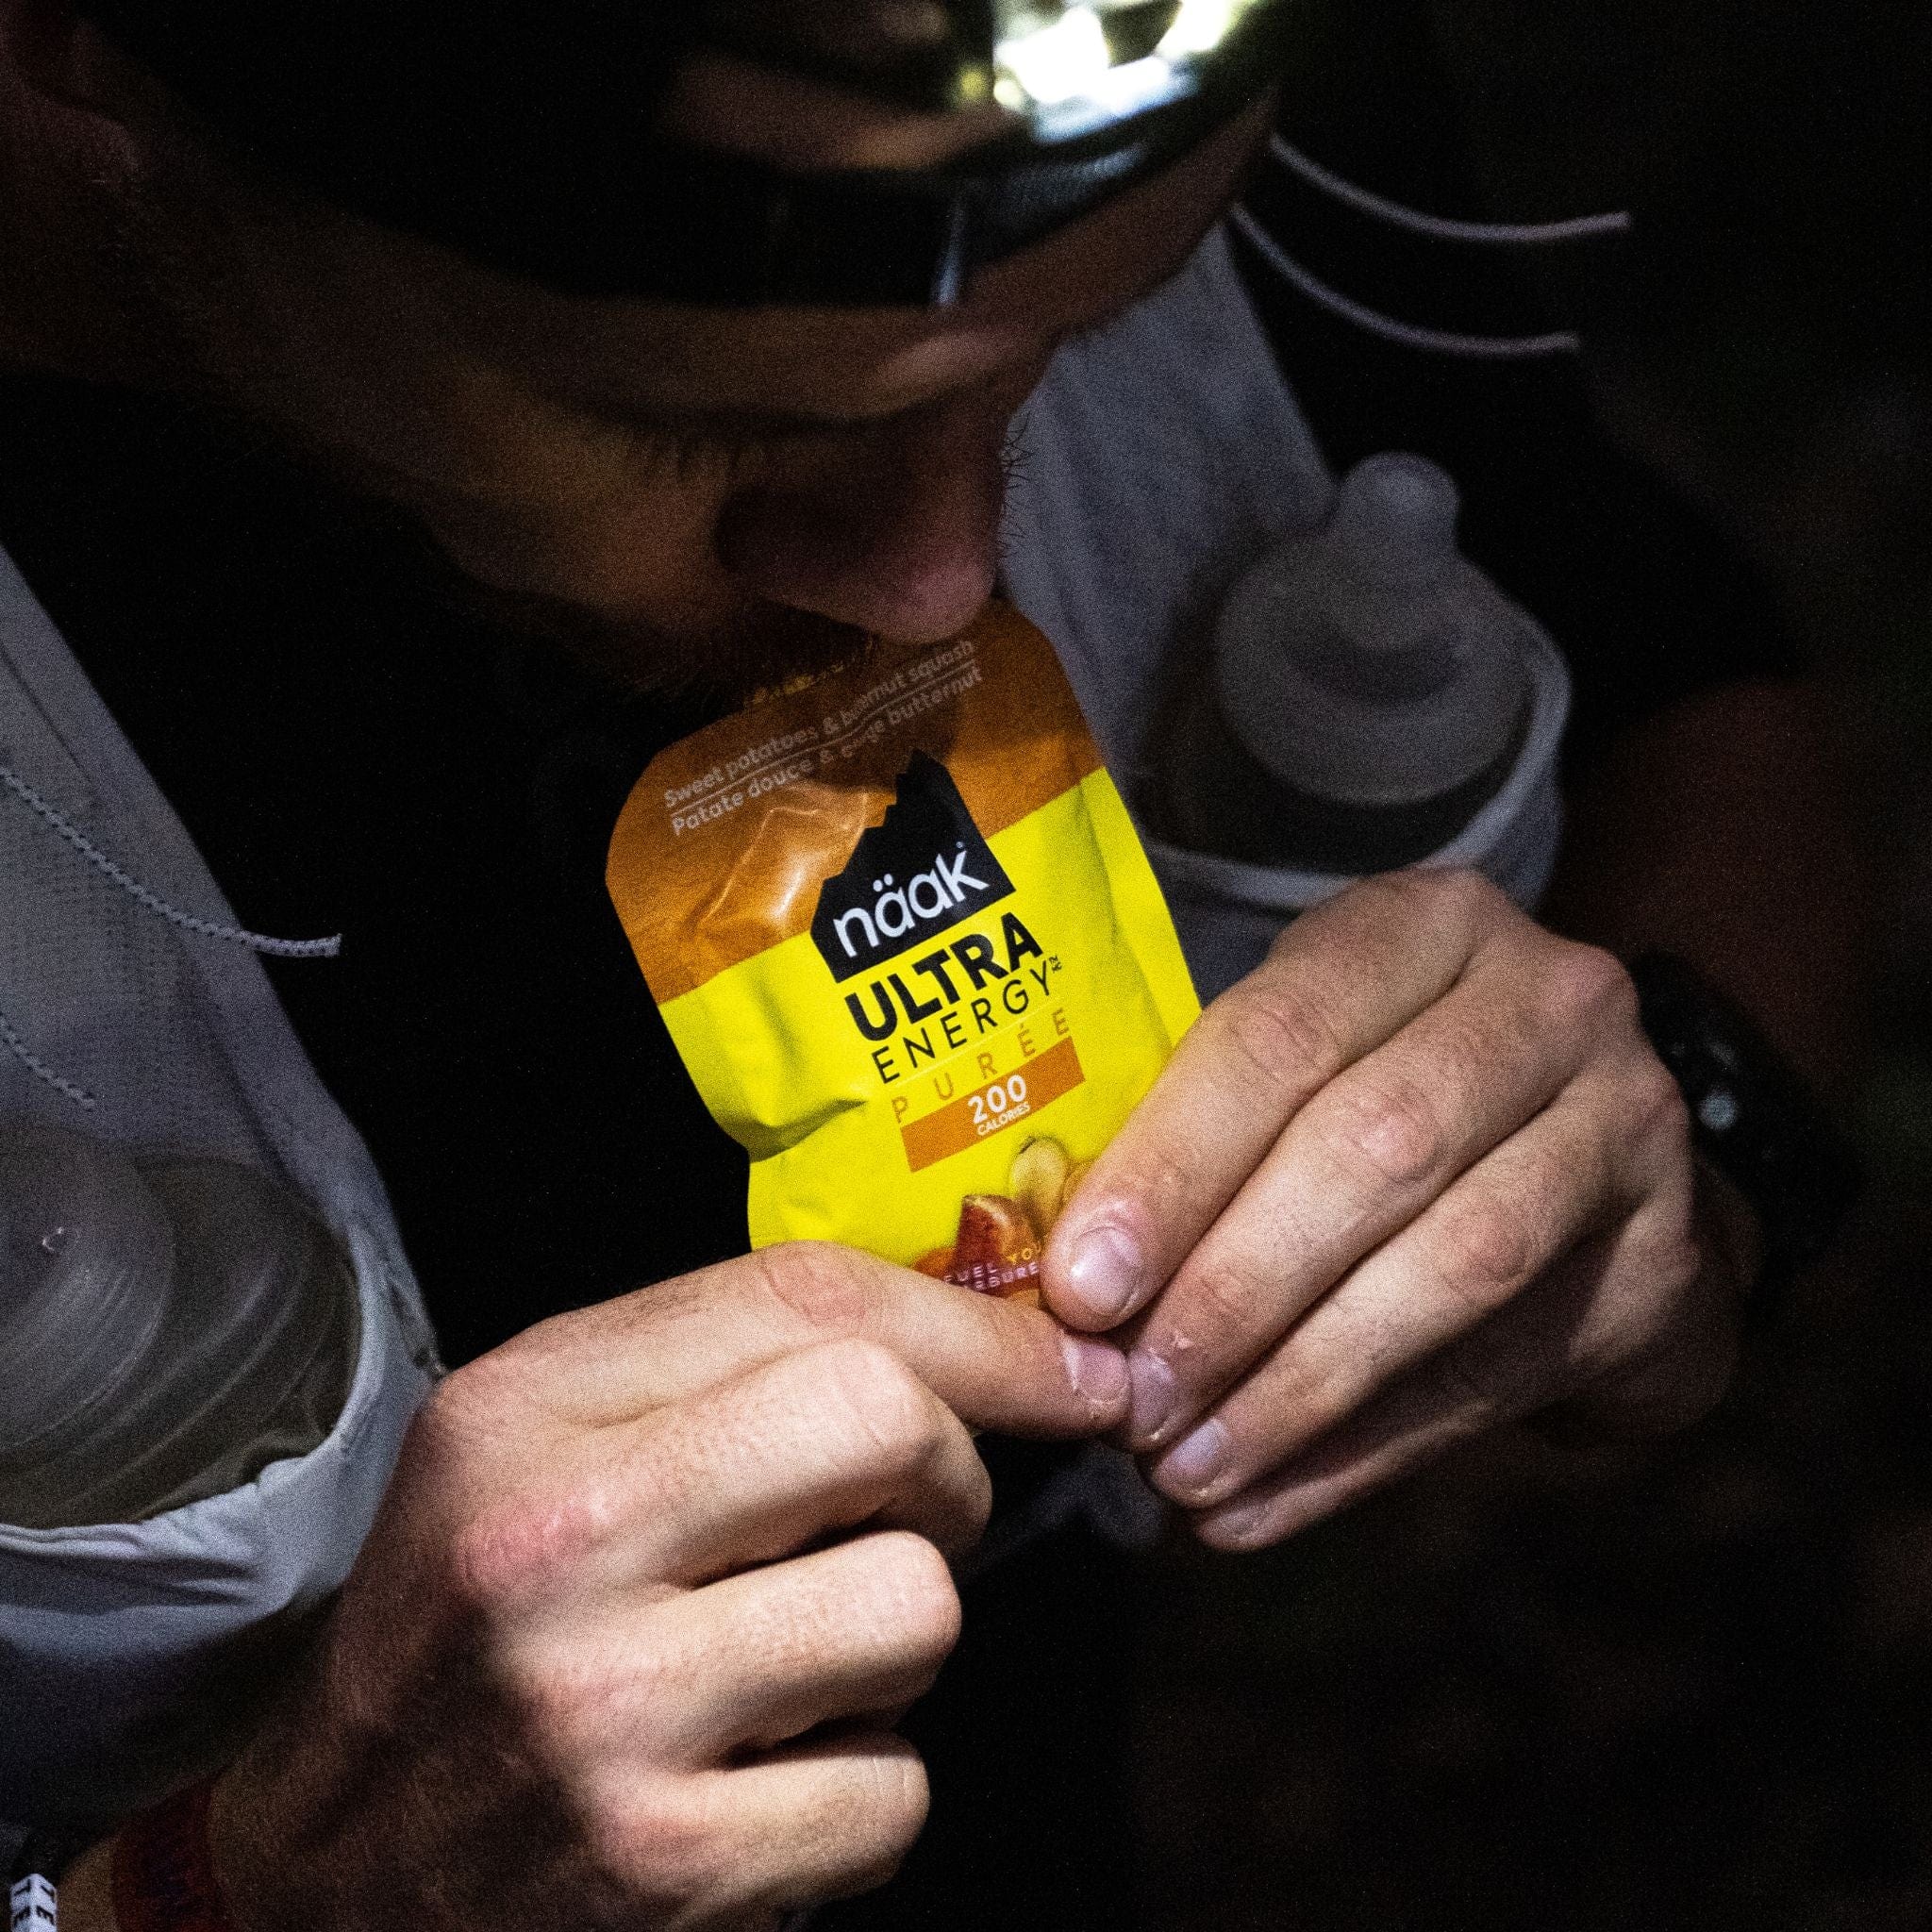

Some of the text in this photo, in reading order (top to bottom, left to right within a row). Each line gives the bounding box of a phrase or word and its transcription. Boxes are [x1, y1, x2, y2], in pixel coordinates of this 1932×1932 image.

[664, 766, 725, 808] Sweet
[725, 725, 819, 781] potatoes
[823, 716, 841, 736] &
[841, 673, 908, 727] bernut
[908, 641, 974, 683] squash
[671, 791, 744, 837] Patate
[748, 758, 814, 799] douce
[819, 749, 834, 765] &
[887, 666, 983, 726] butternut
[832, 850, 990, 958] näak
[844, 911, 1043, 1041] ULTRA
[872, 959, 1051, 1084] ENERGY
[891, 1007, 1070, 1124] PURÉE
[967, 1074, 1027, 1124] 200
[976, 1101, 1031, 1137] CALORIES
